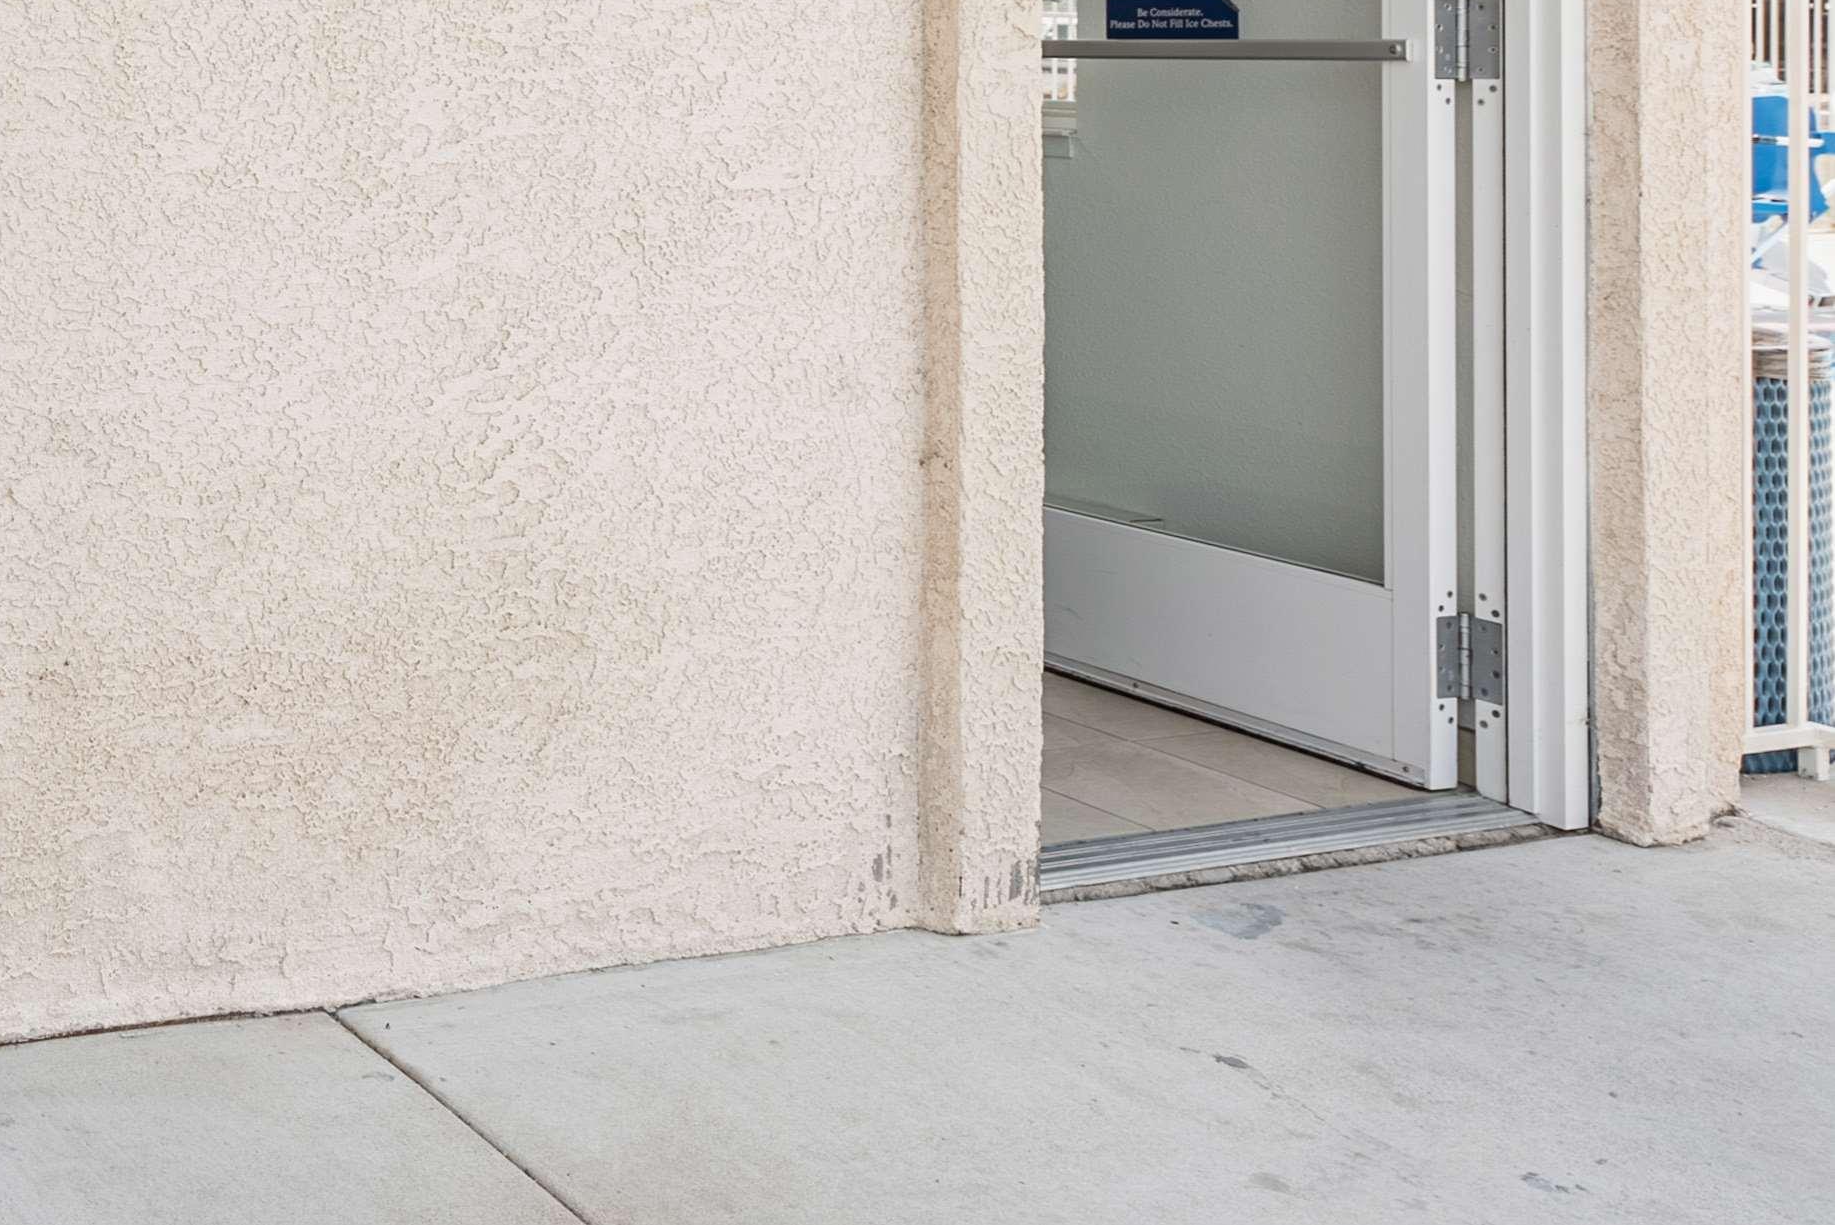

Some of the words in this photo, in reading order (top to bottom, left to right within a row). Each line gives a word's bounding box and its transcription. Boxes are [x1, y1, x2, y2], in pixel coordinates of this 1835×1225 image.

[1137, 7, 1147, 17] Be
[1149, 7, 1204, 17] Considerate.
[1109, 19, 1135, 29] Please
[1137, 19, 1150, 29] Do
[1151, 19, 1168, 29] Not
[1169, 18, 1184, 28] Fill
[1185, 18, 1199, 28] Ice
